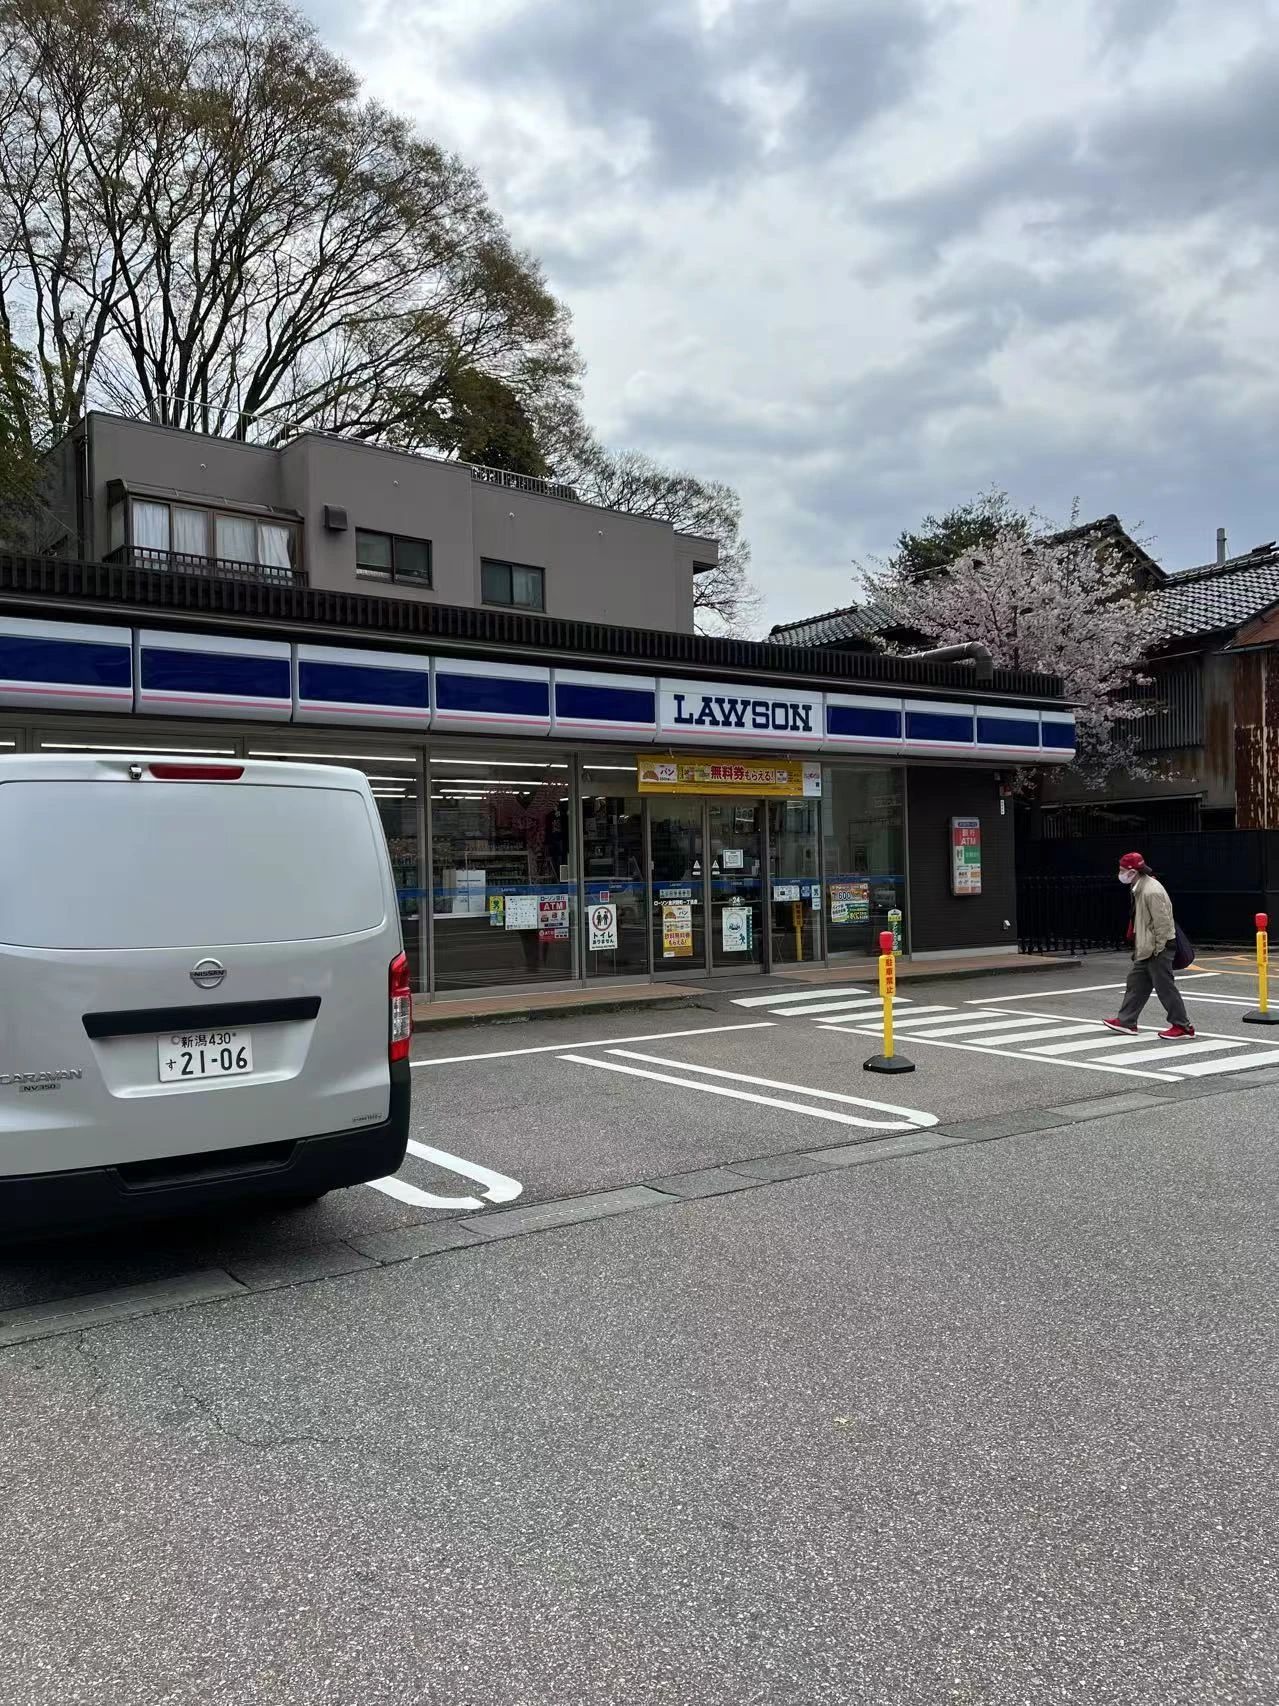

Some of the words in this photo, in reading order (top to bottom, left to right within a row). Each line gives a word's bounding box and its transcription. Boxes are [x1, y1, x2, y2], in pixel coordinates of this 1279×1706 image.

[674, 694, 812, 732] LAWSON
[543, 902, 563, 910] ATM
[593, 931, 613, 939] トイレ
[194, 970, 226, 978] NISSAN
[165, 1058, 177, 1072] す
[180, 1046, 248, 1076] 21-06
[0, 1068, 83, 1085] CARAVAN
[23, 1083, 57, 1092] NV350
